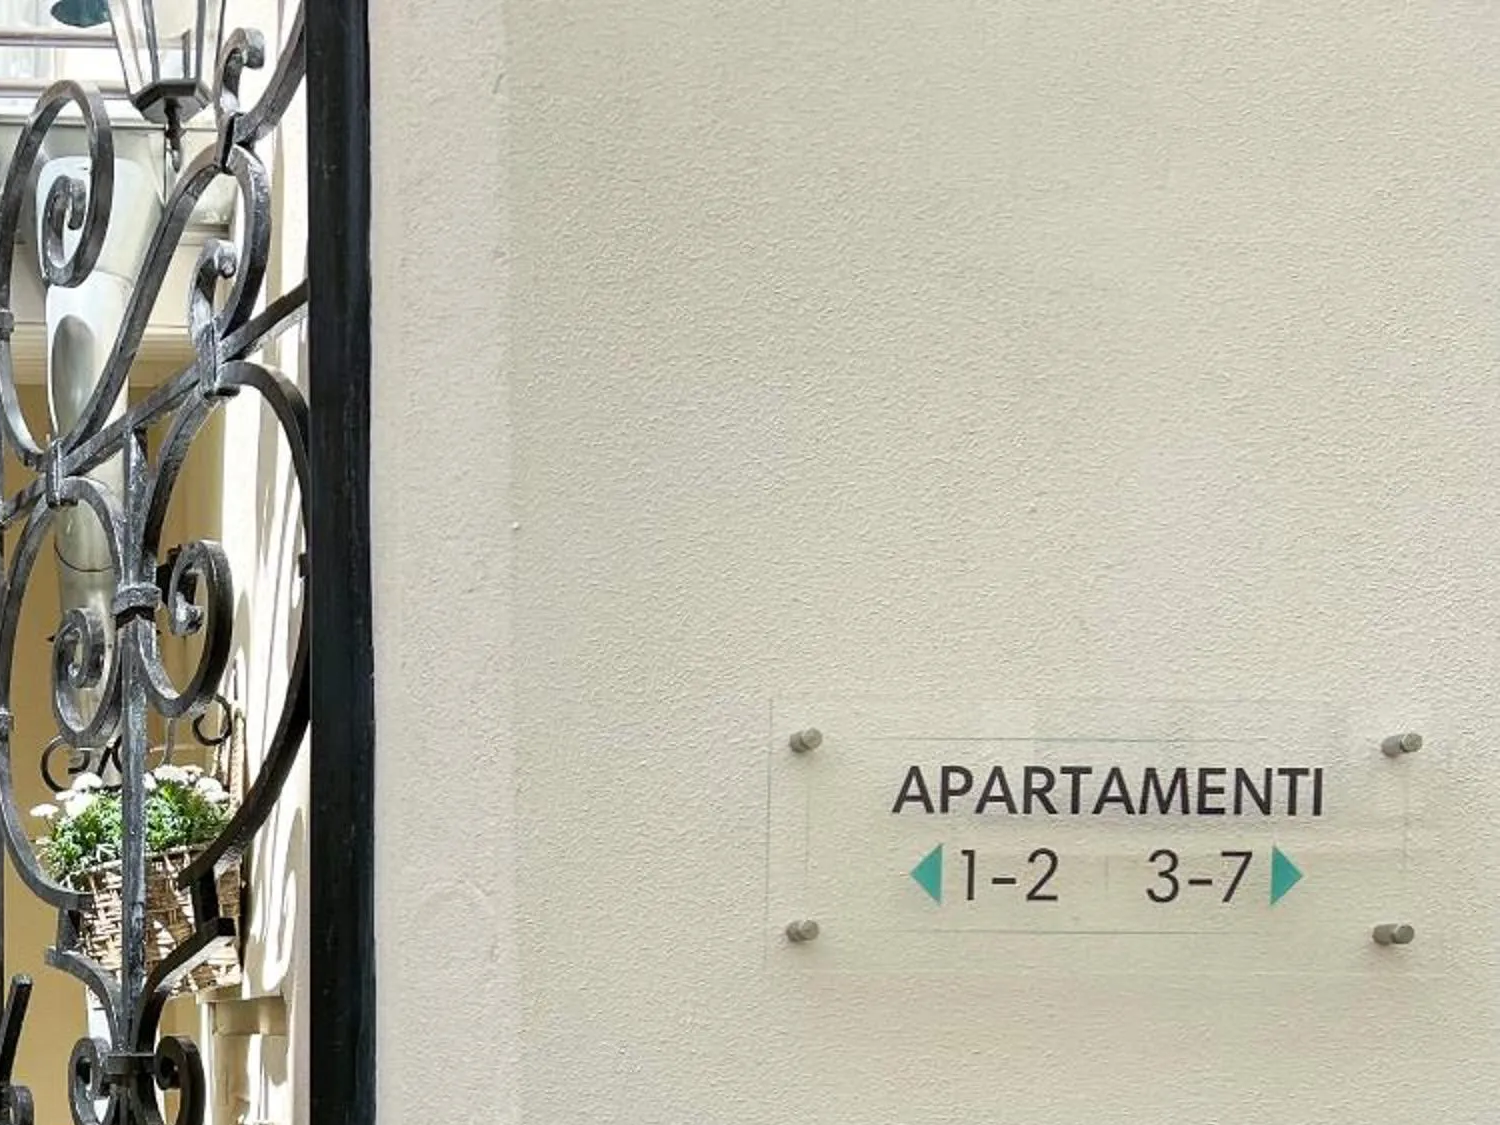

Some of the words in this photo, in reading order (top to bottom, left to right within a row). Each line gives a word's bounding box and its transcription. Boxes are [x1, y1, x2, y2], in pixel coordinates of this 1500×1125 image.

[891, 764, 1324, 817] APARTAMENTI
[960, 847, 1060, 902] 1-2
[1145, 848, 1255, 904] 3-7
